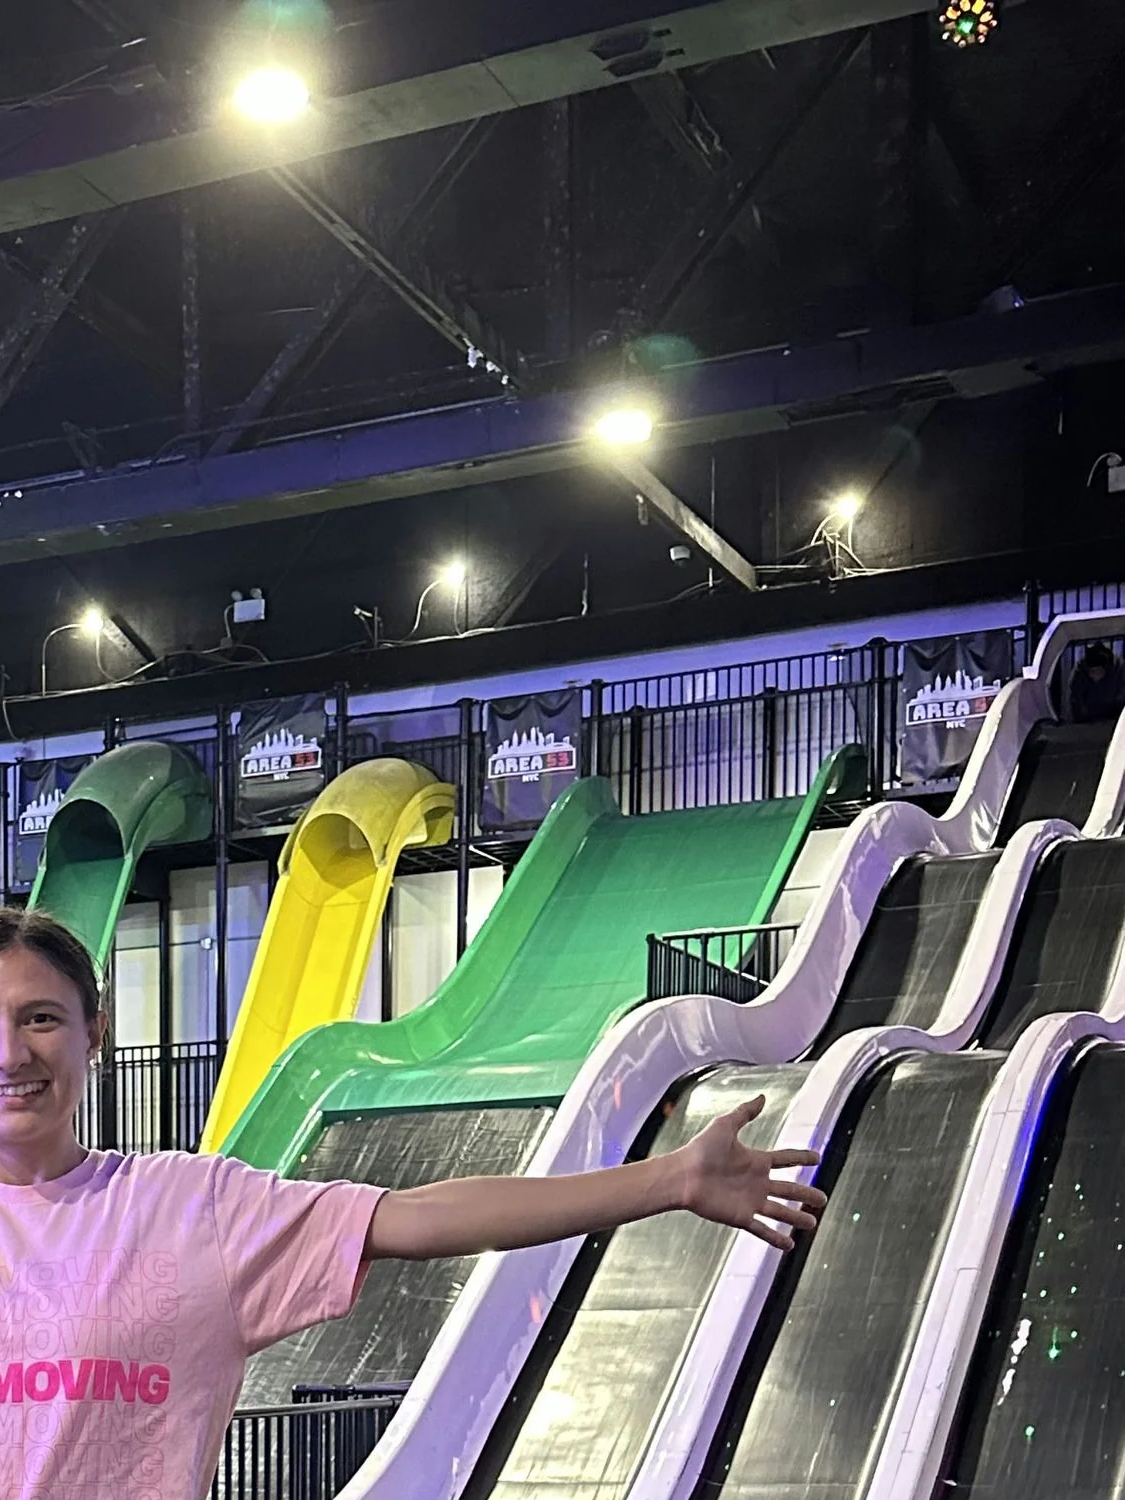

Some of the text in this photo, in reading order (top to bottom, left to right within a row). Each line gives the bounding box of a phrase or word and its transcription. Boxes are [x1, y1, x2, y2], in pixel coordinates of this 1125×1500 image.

[913, 700, 970, 721] AREA
[946, 719, 966, 729] NYC
[247, 751, 317, 773] AREA 53
[494, 751, 569, 774] AREA 53
